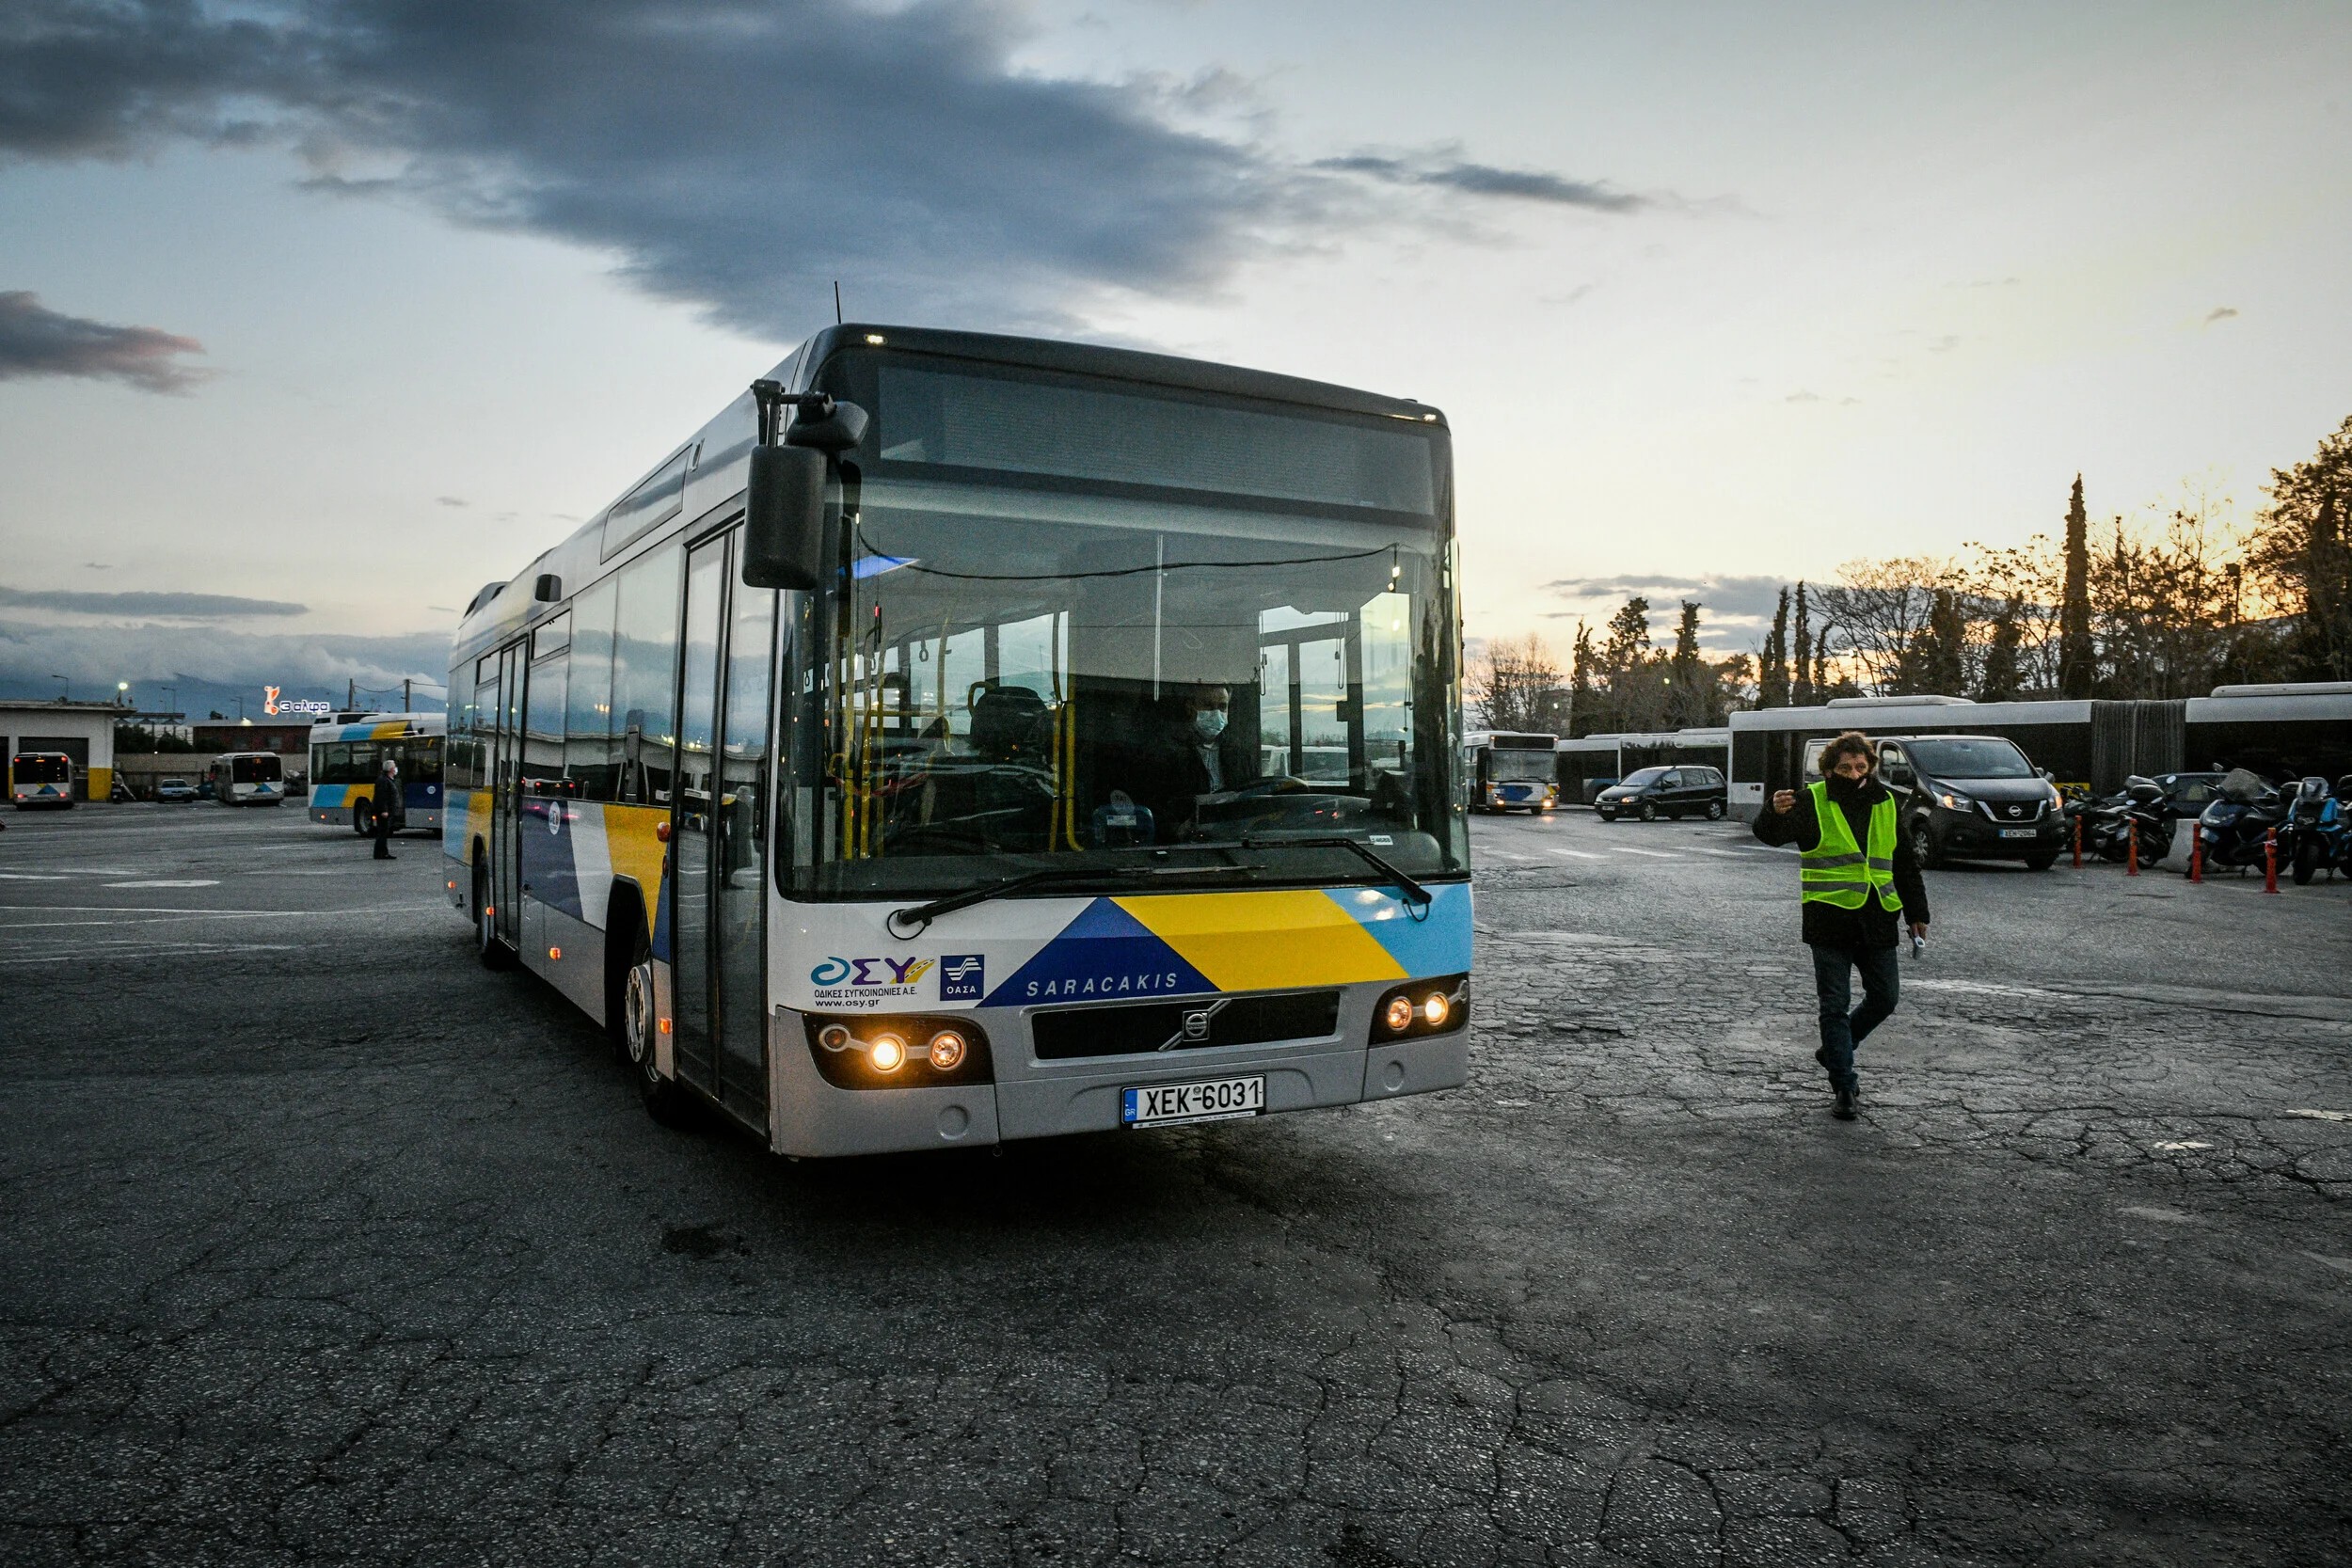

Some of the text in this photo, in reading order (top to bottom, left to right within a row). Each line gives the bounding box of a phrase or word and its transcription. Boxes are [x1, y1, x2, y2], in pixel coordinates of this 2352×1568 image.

[946, 986, 977, 994] ΟΑΣΑ
[1026, 973, 1177, 997] SARACAKIS
[814, 987, 917, 998] ΟΔΙΚΕΣ ΣΥΓΚΟΙΝΩΝΙΕΣ Α.Ε.
[815, 998, 881, 1007] www.osy.gr
[1145, 1080, 1259, 1117] XEK-6031
[1125, 1108, 1136, 1117] GR
